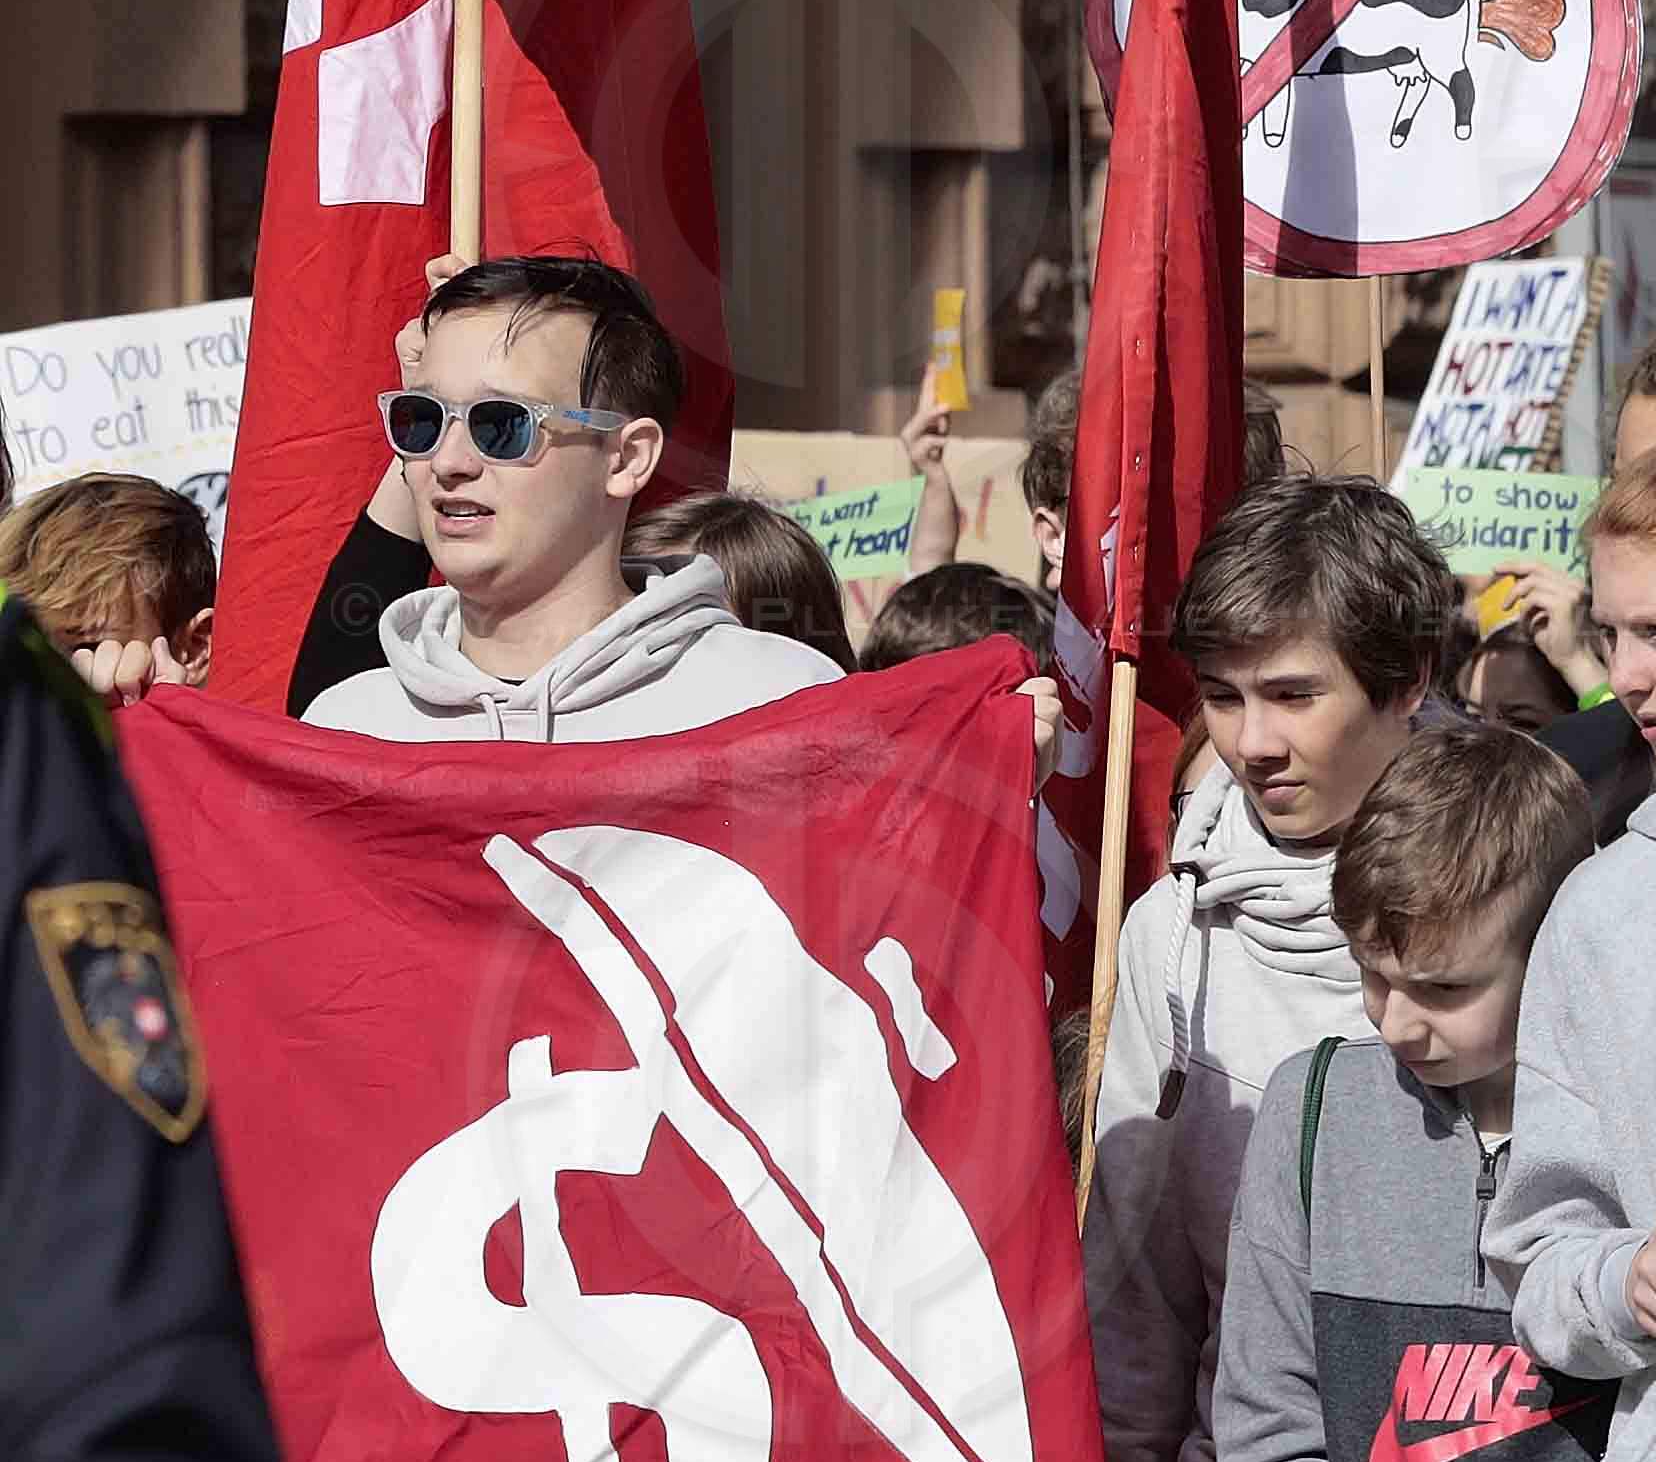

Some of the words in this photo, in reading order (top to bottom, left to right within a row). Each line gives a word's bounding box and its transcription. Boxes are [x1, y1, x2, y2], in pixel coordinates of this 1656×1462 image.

[1463, 279, 1482, 328] I
[1483, 270, 1569, 330] WANT
[5, 346, 68, 396] Do
[96, 343, 162, 400] you
[1436, 340, 1514, 396] HOT
[1503, 342, 1570, 396] DATE
[16, 420, 68, 465] to
[91, 395, 149, 451] eat
[1502, 399, 1558, 441] HOT
[820, 490, 880, 527] want
[1440, 476, 1474, 507] to
[1495, 483, 1580, 513] show
[1393, 1342, 1542, 1422] NIKE
